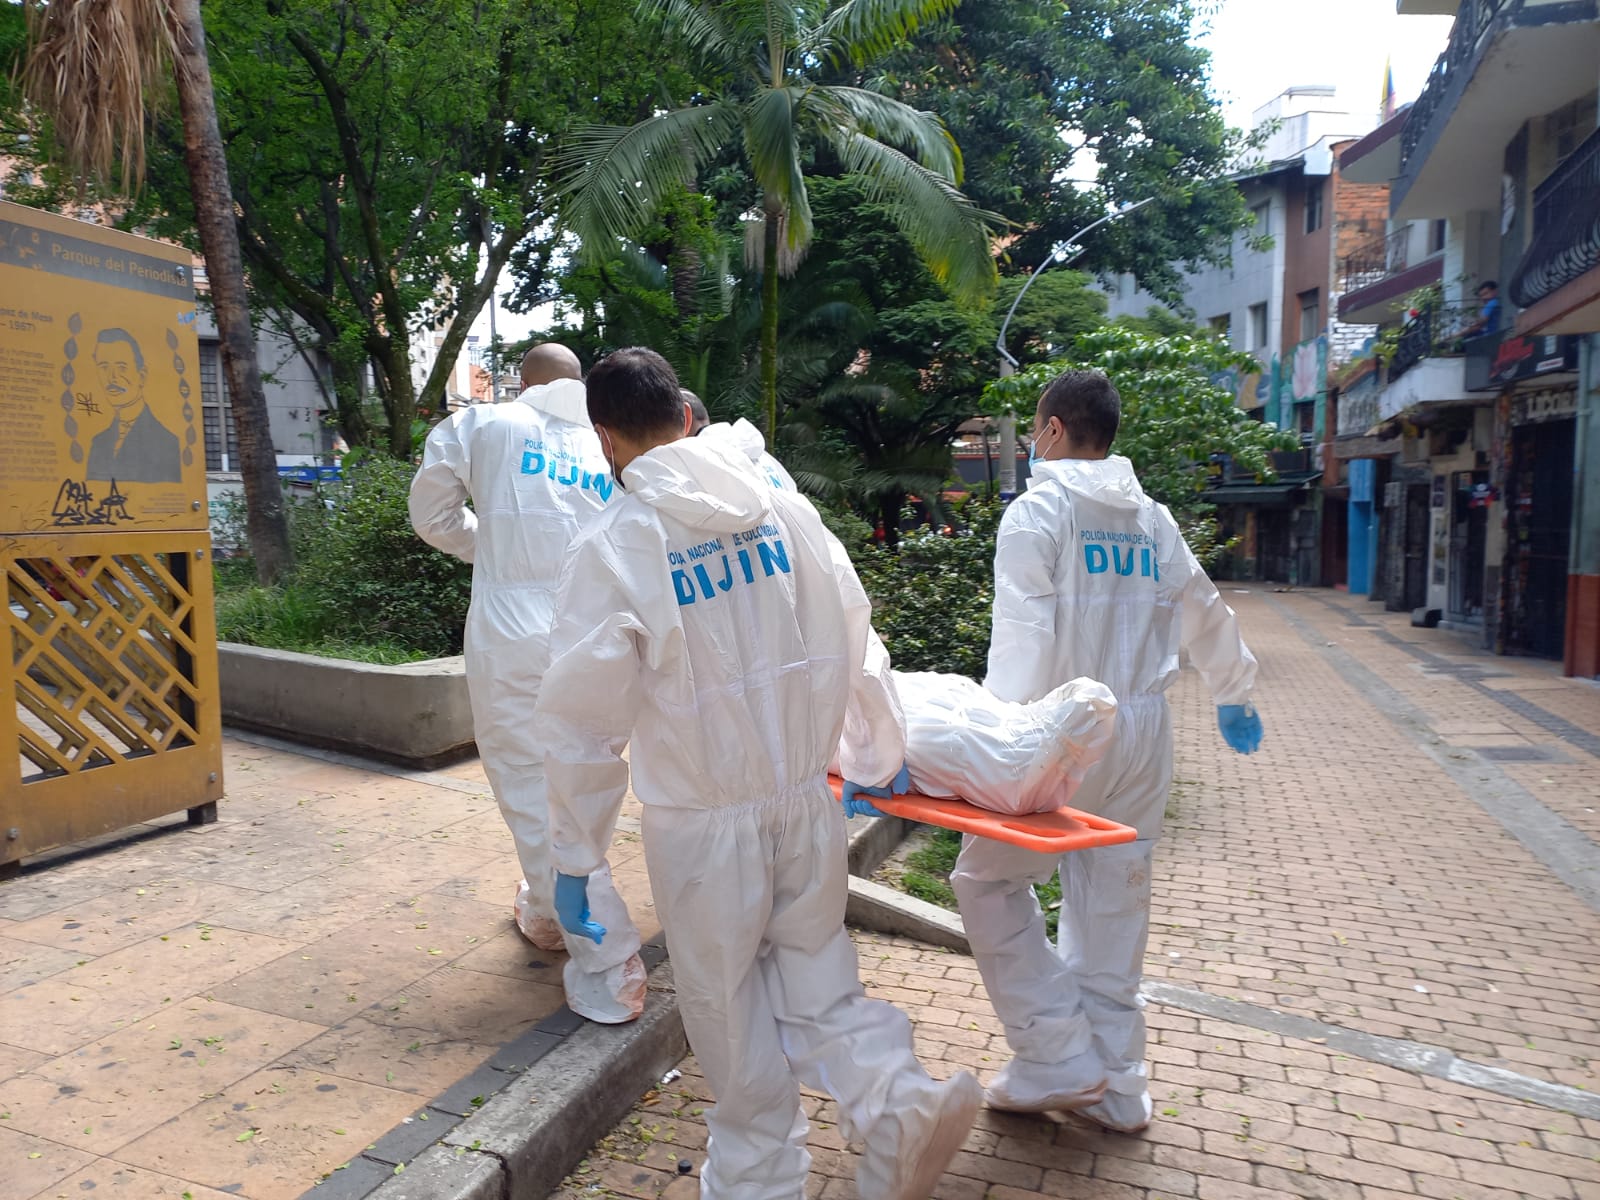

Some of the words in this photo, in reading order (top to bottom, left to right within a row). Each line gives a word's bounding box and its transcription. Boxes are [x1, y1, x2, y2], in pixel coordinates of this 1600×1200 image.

[52, 243, 101, 268] Parque
[105, 257, 125, 272] del
[521, 451, 613, 503] DIJIN
[686, 537, 725, 562] NACIONA
[742, 524, 781, 543] COLOMBIA
[671, 539, 791, 606] DIJIN
